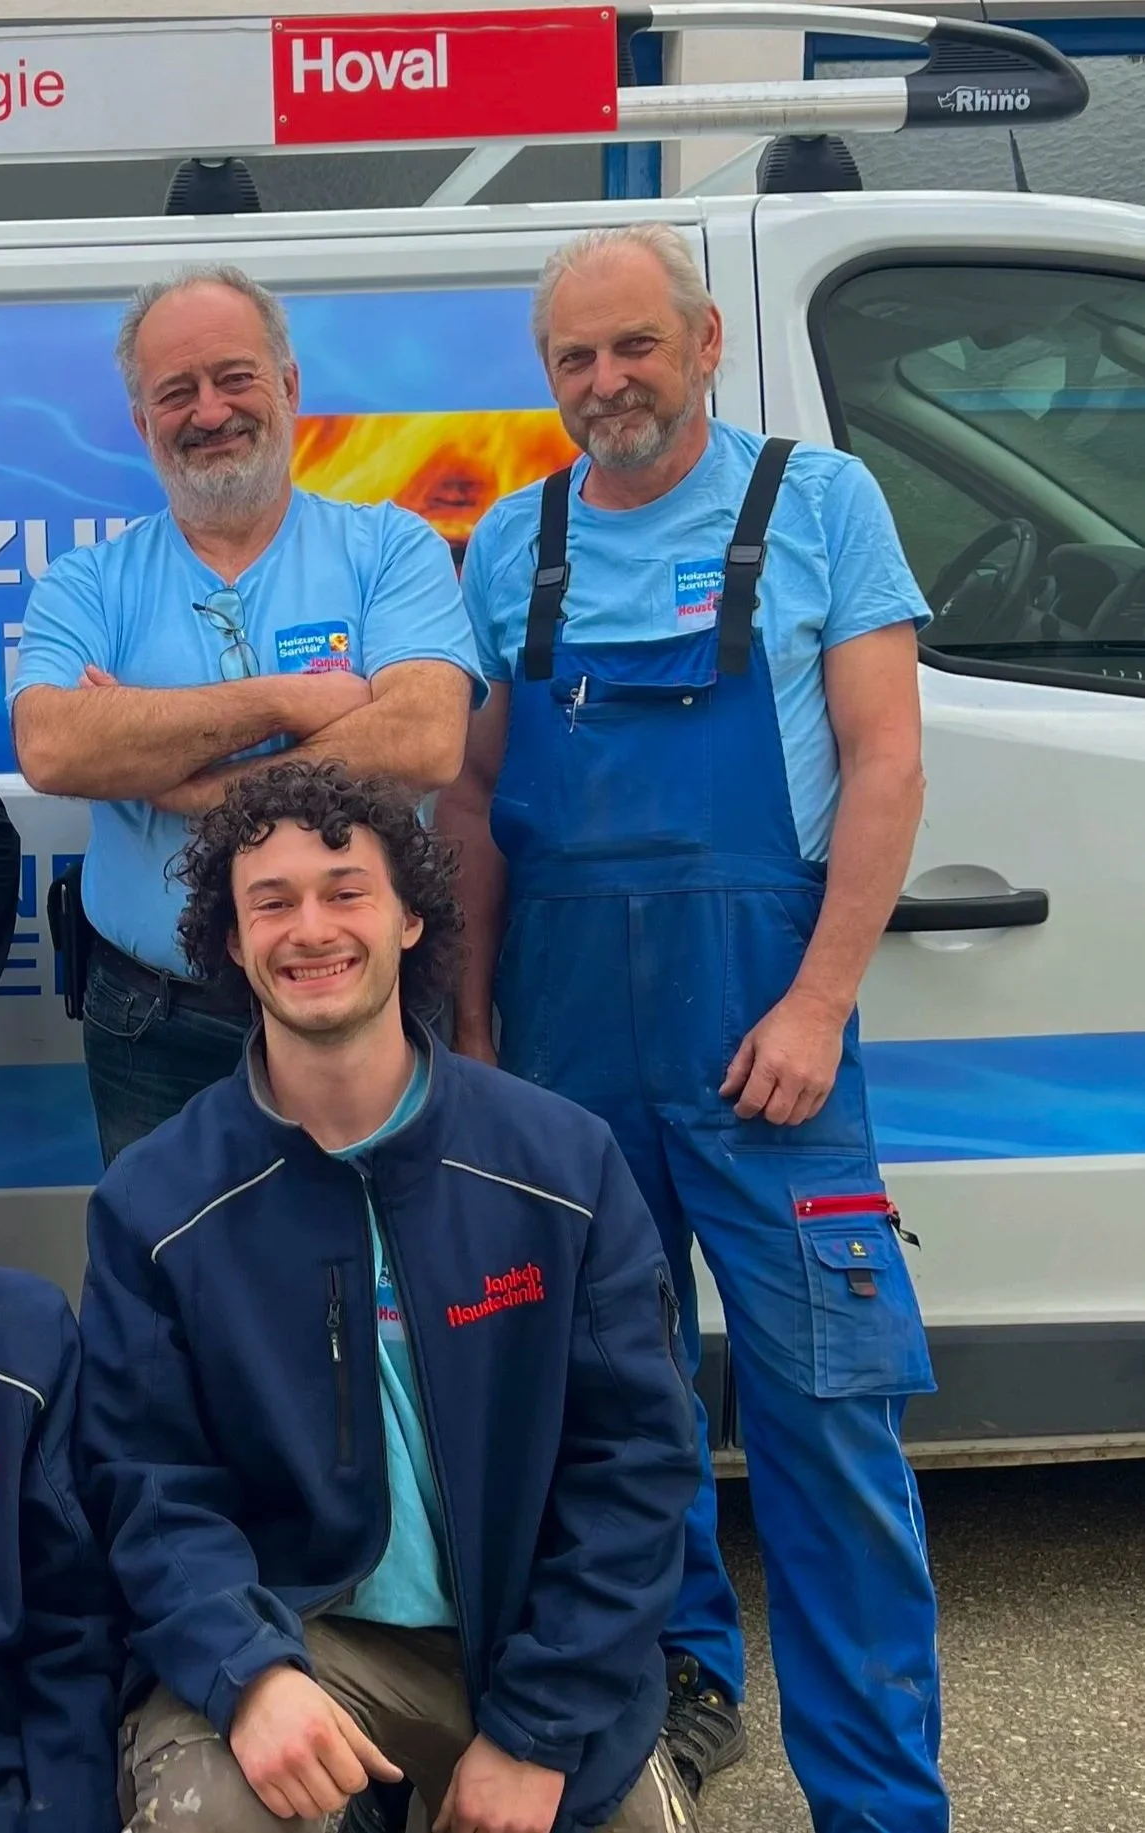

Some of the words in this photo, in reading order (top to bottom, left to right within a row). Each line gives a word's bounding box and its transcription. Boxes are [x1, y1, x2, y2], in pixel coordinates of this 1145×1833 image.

[292, 33, 448, 93] Hoval
[955, 89, 1031, 113] Rhino
[278, 635, 326, 648] Heizung
[279, 644, 323, 658] Sanitär
[485, 1261, 543, 1295] Janisch
[446, 1281, 545, 1328] Haustechnik
